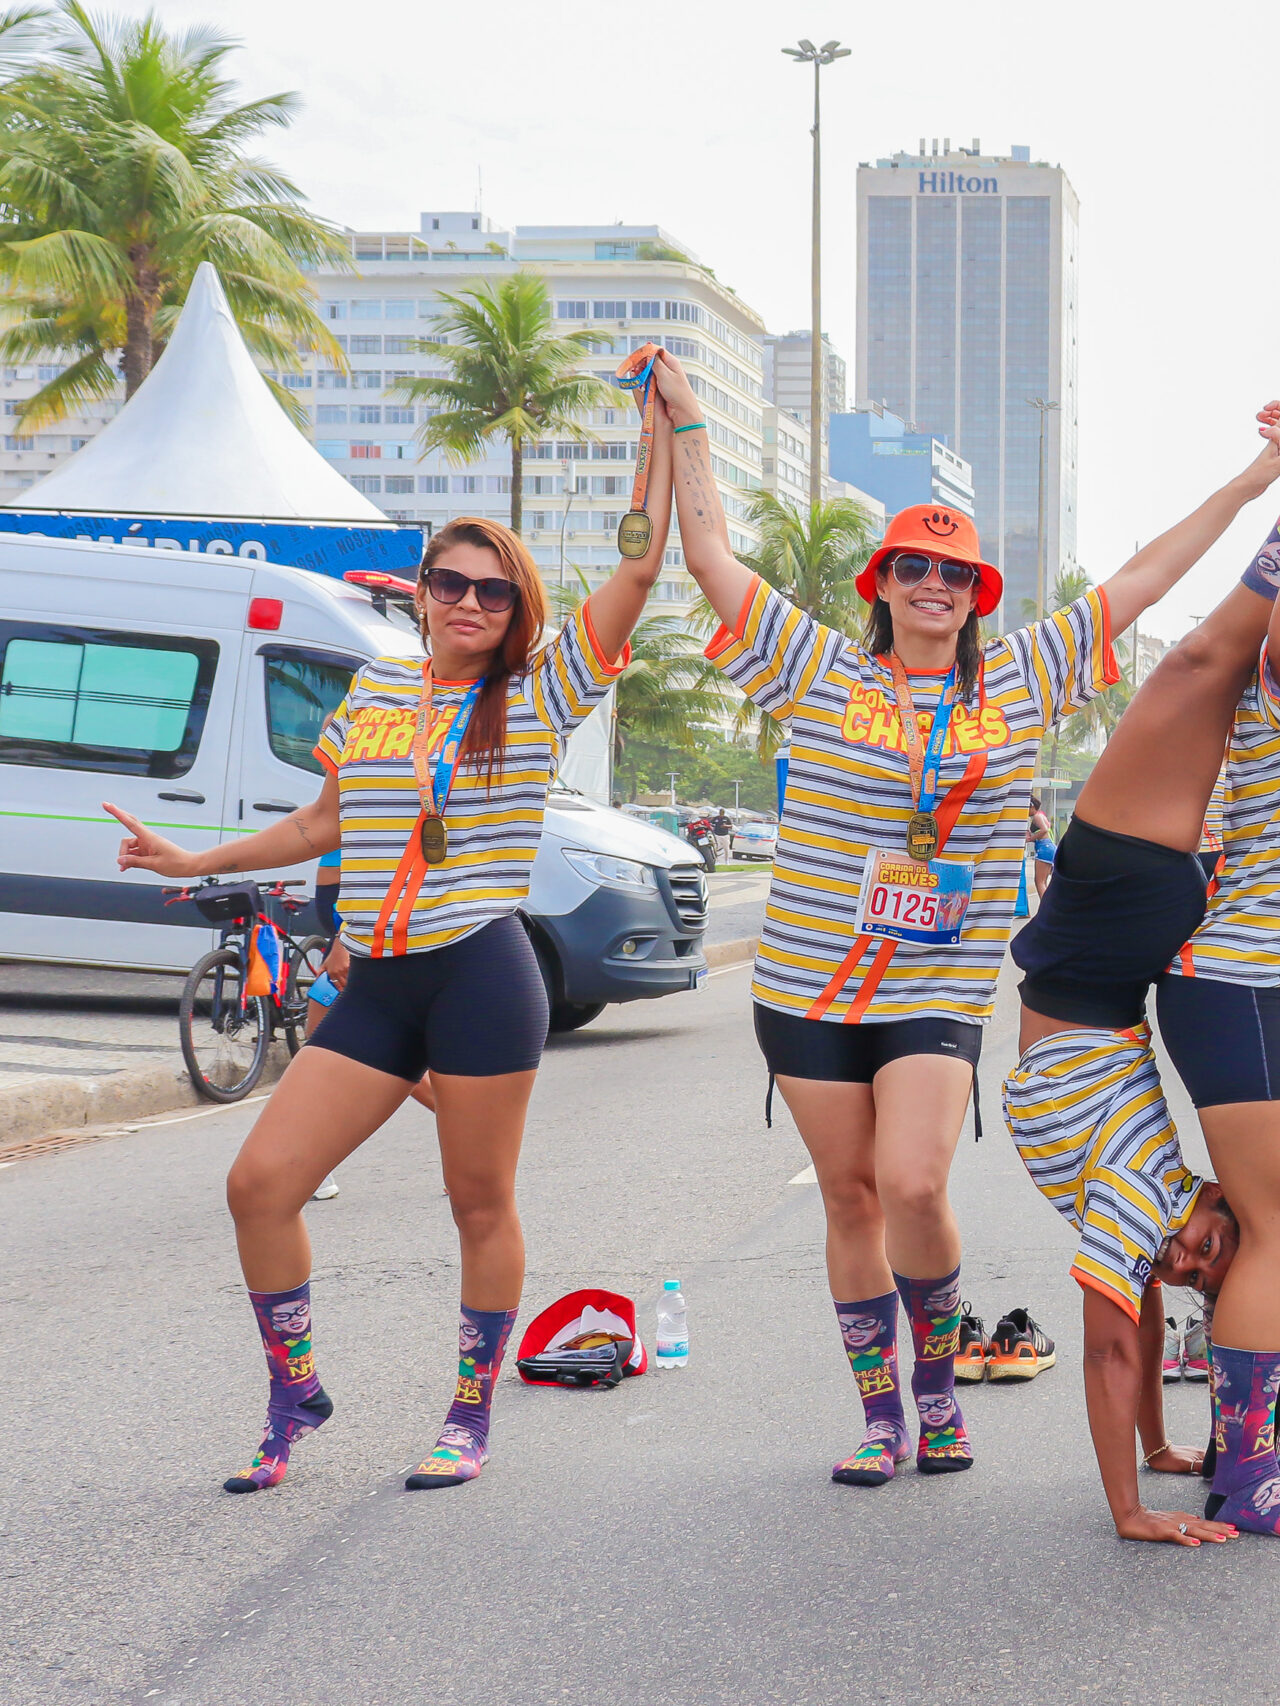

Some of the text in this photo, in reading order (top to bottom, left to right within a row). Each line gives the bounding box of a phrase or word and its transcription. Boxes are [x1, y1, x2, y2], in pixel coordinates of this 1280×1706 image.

[918, 172, 998, 193] Hilton
[851, 683, 931, 730] CORA
[842, 703, 1010, 758] CHES
[880, 863, 927, 874] CORRIDA DO
[879, 870, 939, 887] CHAVES
[871, 887, 938, 926] 0125
[289, 1362, 316, 1377] NH
[457, 1386, 482, 1402] HA
[417, 1463, 457, 1474] NHA
